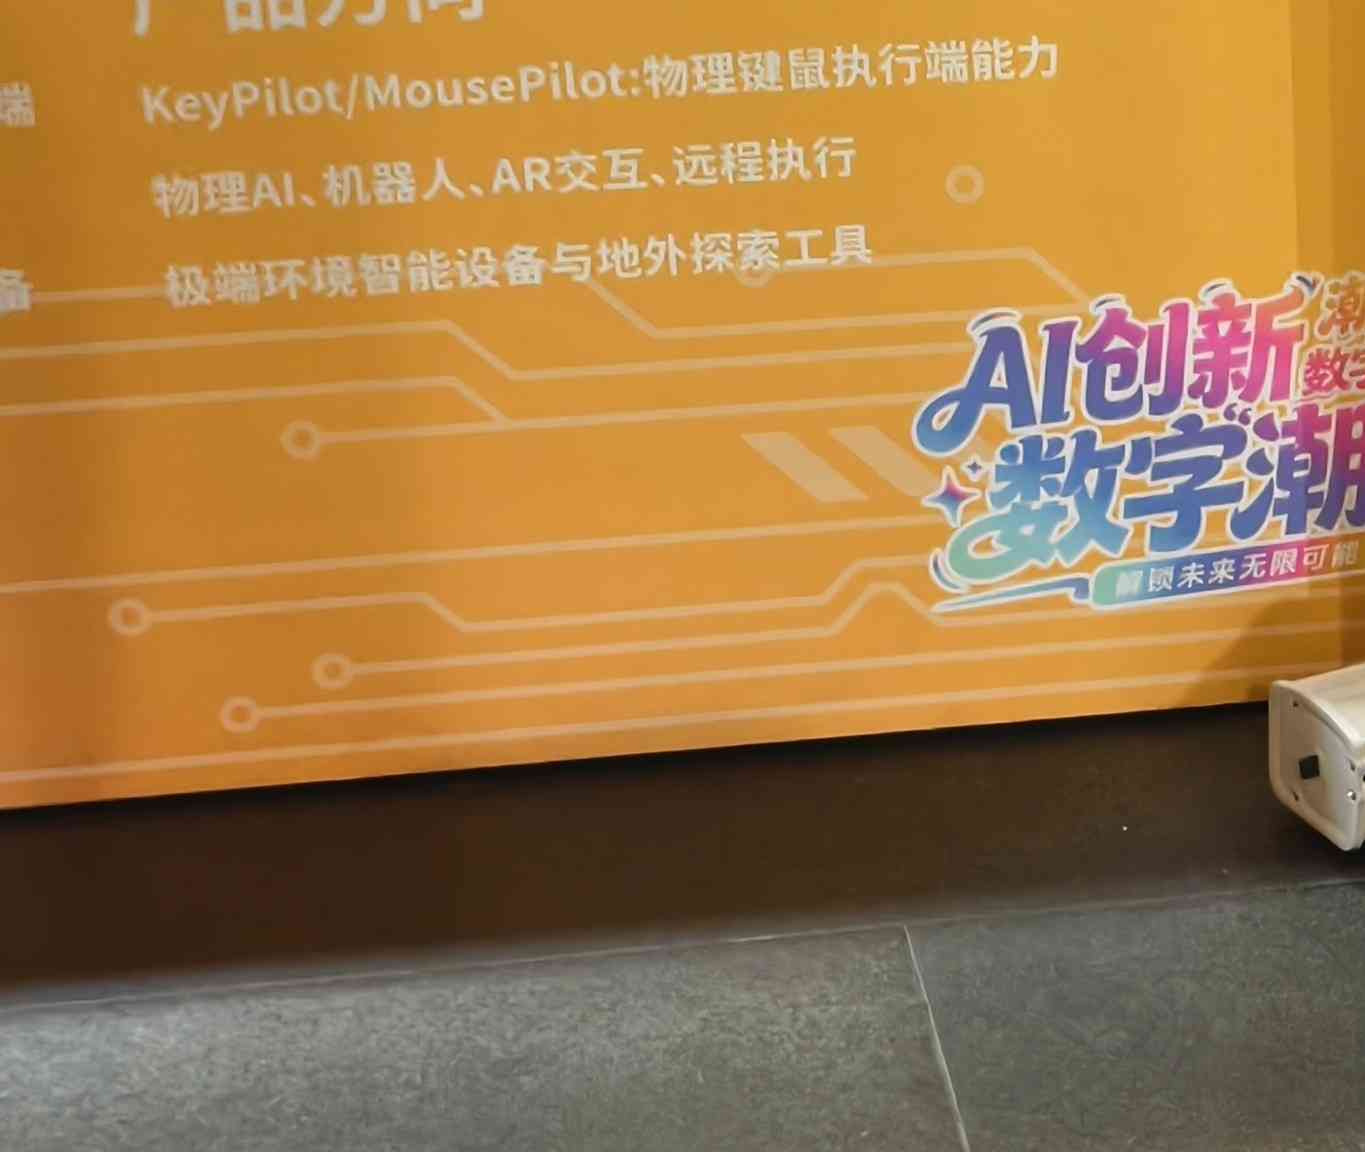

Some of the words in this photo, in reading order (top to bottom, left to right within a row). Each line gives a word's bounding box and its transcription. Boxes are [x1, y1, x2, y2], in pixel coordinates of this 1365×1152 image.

[152, 136, 857, 218] 物理AI、机器人、AR交互、远程执行
[165, 224, 873, 309] 极端环境智能设备与地外探索工具
[914, 288, 1306, 453] AI创新
